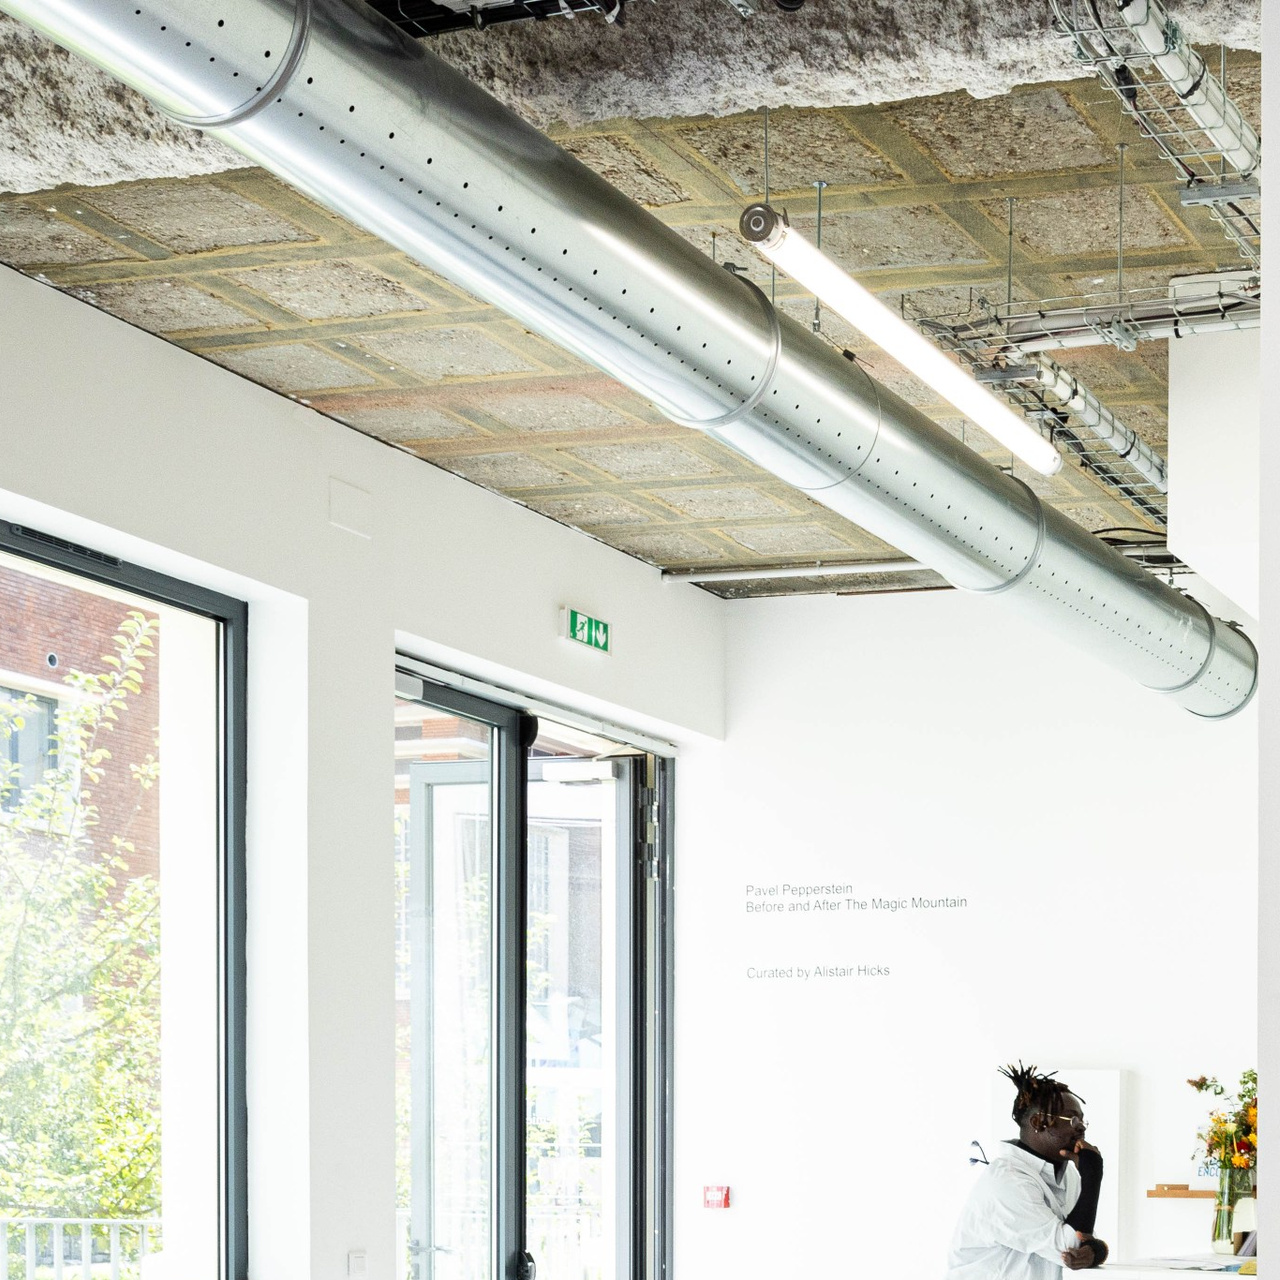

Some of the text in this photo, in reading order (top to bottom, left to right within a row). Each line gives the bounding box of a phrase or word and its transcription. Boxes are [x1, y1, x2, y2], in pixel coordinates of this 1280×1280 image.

[746, 883, 853, 897] Pavel Pepperstein
[746, 896, 968, 913] Before and After The Magic Mountain
[746, 964, 891, 981] Curated by Alistair Hicks
